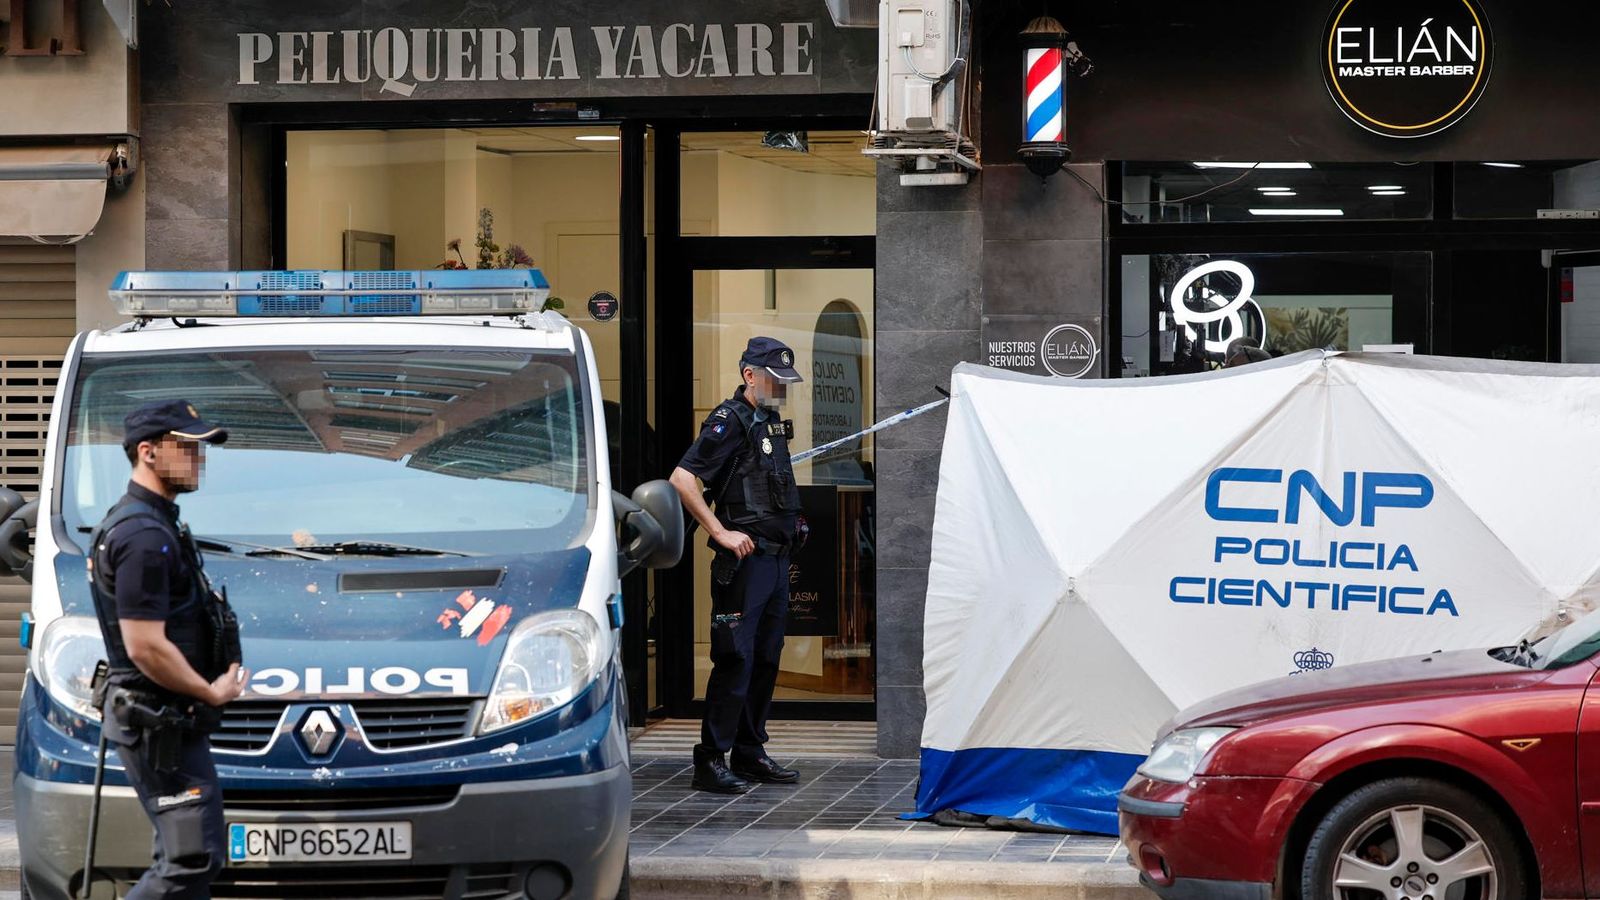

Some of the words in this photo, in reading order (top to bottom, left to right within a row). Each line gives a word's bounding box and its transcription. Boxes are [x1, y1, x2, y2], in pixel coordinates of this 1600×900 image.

[1337, 18, 1477, 63] ELIÁN
[237, 27, 581, 97] PELUQUERIA
[591, 22, 814, 79] YACARE
[1339, 66, 1406, 77] MASTER
[1410, 65, 1474, 76] BARBER
[988, 341, 1036, 353] NUESTROS
[988, 355, 1036, 367] SERVICIOS
[1047, 340, 1091, 356] ELIÁN
[1205, 467, 1435, 527] CNP
[1214, 536, 1419, 572] POLICIA
[788, 592, 818, 602] LASM
[1169, 576, 1459, 616] CIENTIFICA
[247, 827, 407, 857] CNP6652AL
